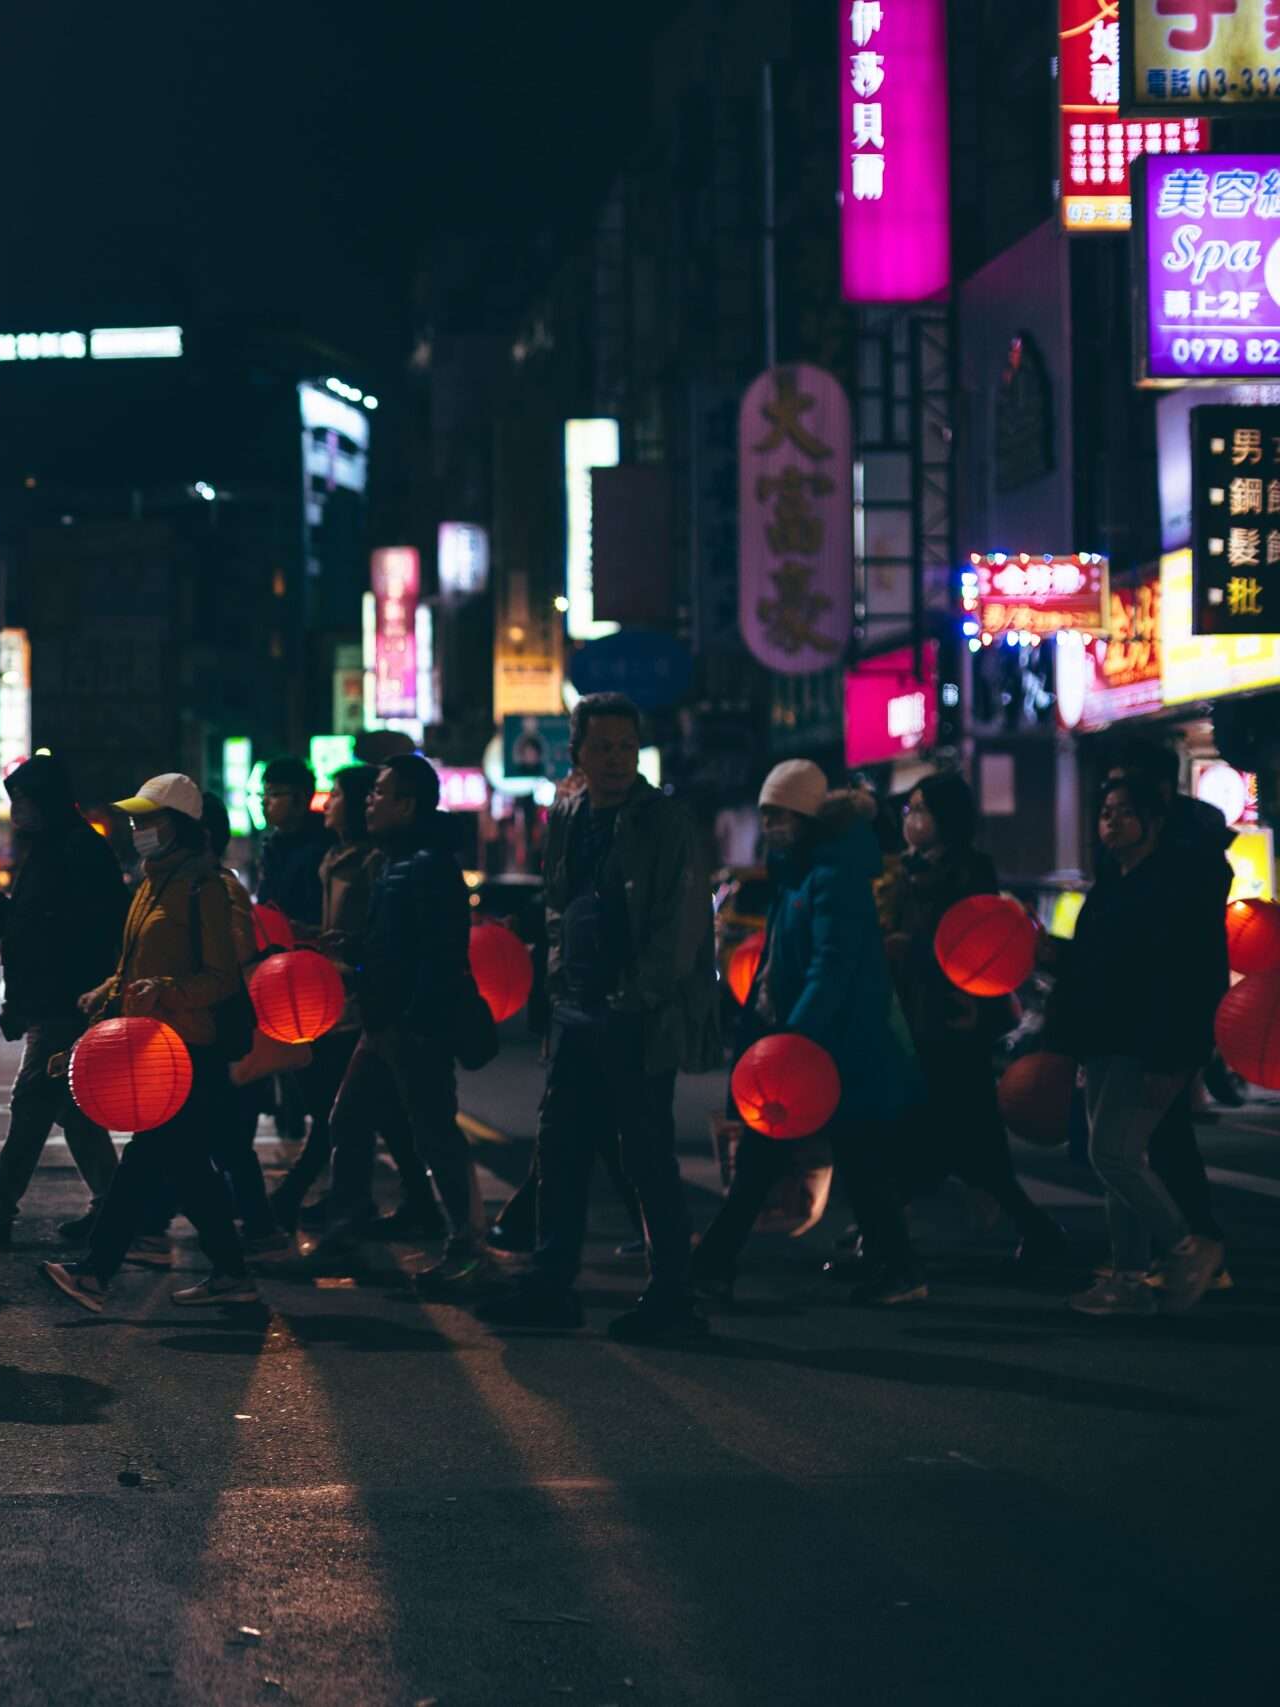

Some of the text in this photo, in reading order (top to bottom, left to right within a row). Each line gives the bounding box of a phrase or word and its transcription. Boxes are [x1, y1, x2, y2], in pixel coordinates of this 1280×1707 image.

[1147, 68, 1191, 97] 電話
[1161, 224, 1261, 285] Spa
[1173, 338, 1280, 362] 0978 82
